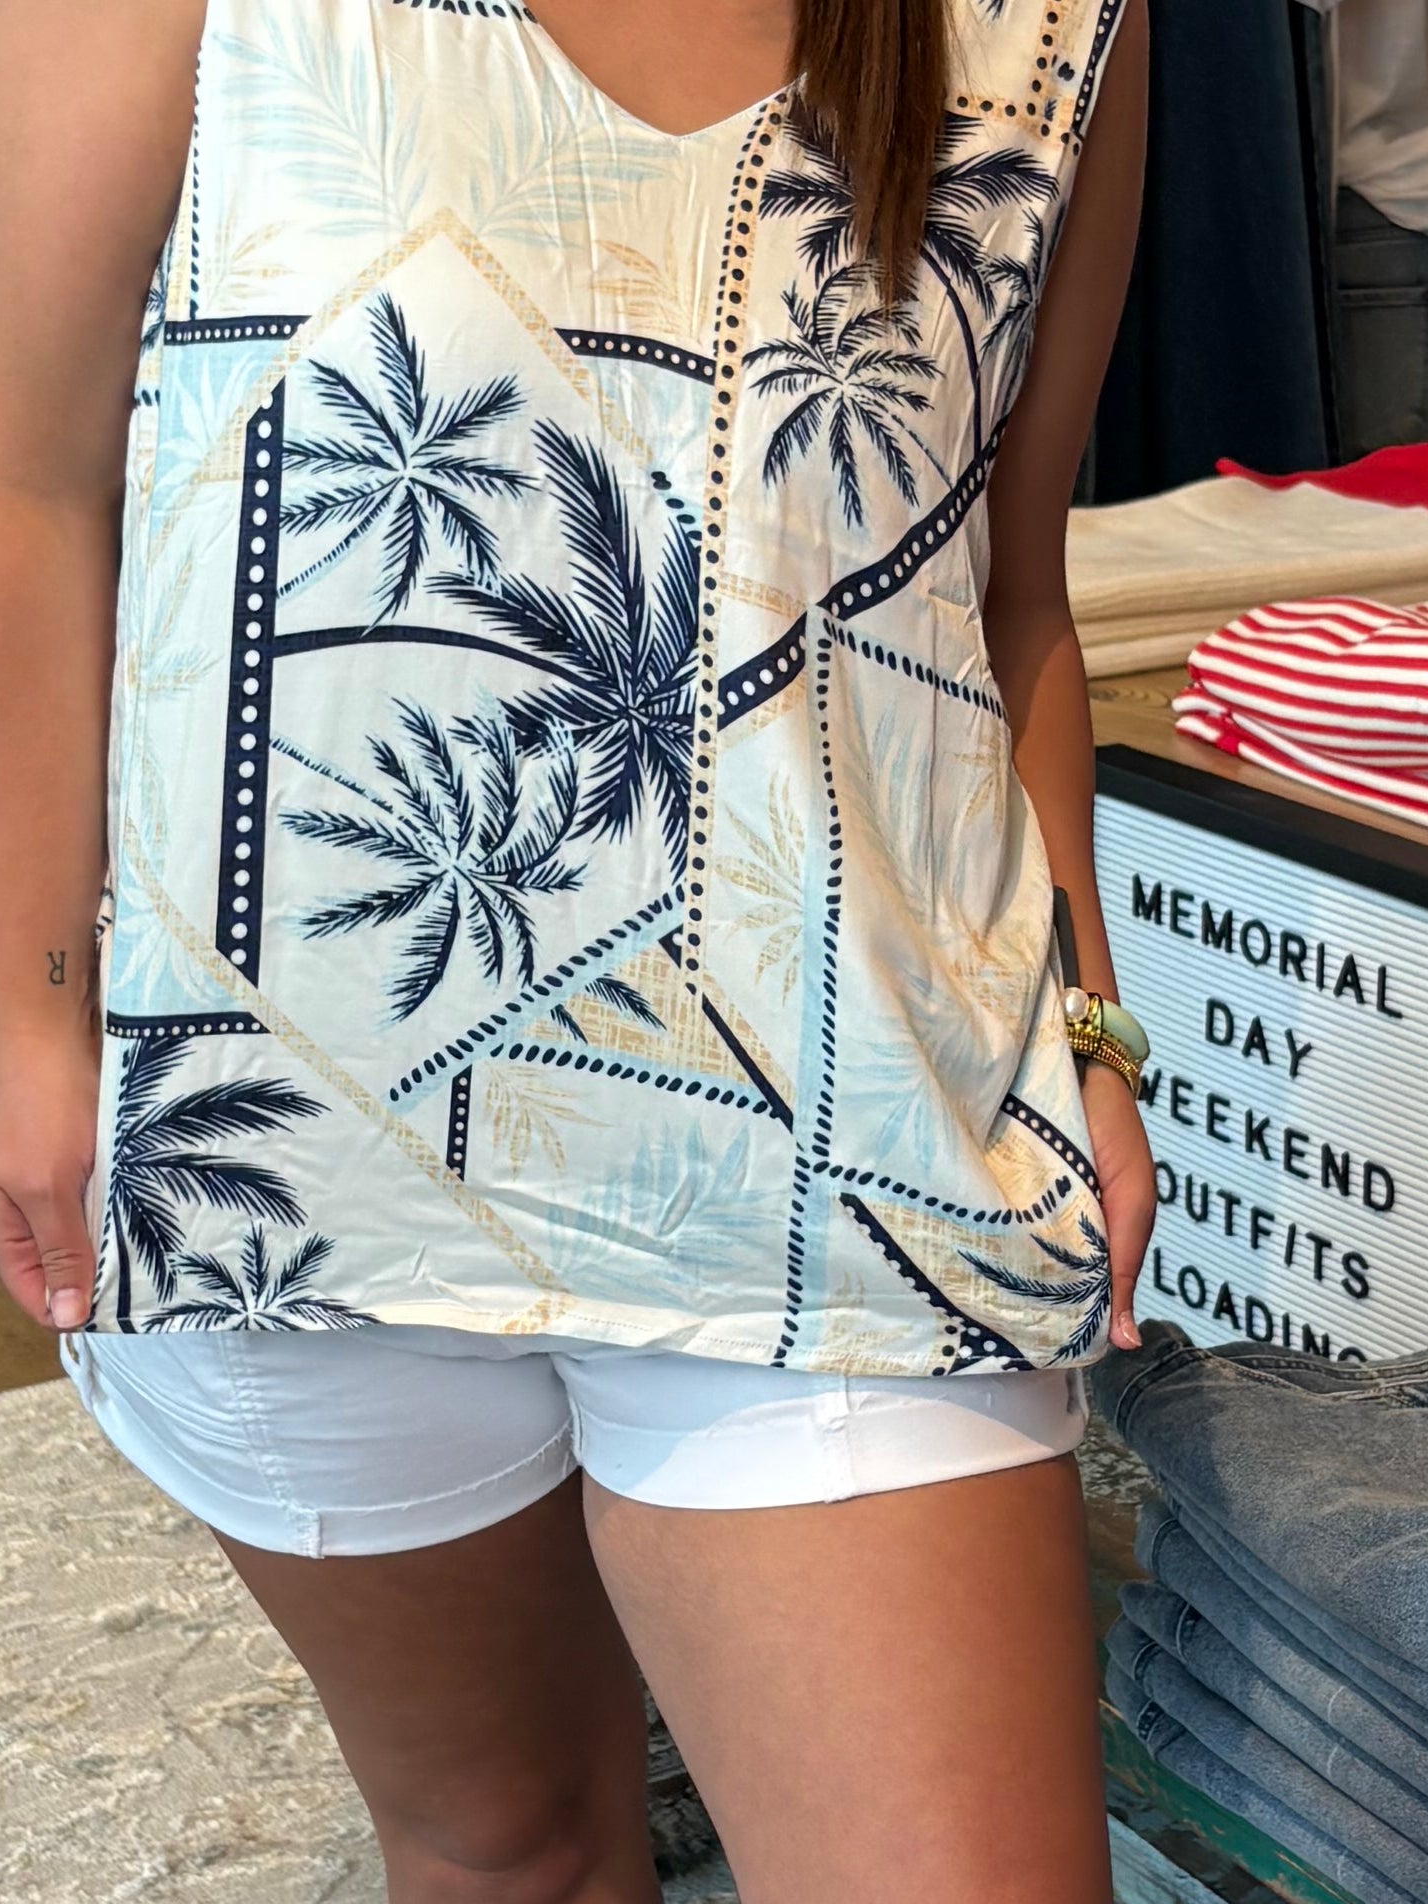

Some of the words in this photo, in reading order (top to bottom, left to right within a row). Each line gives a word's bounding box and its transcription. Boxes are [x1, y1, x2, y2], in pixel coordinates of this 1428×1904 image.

[1132, 872, 1403, 1019] MEMORIAL
[1205, 997, 1313, 1079] DAY
[1154, 1160, 1370, 1299] OUTFITS
